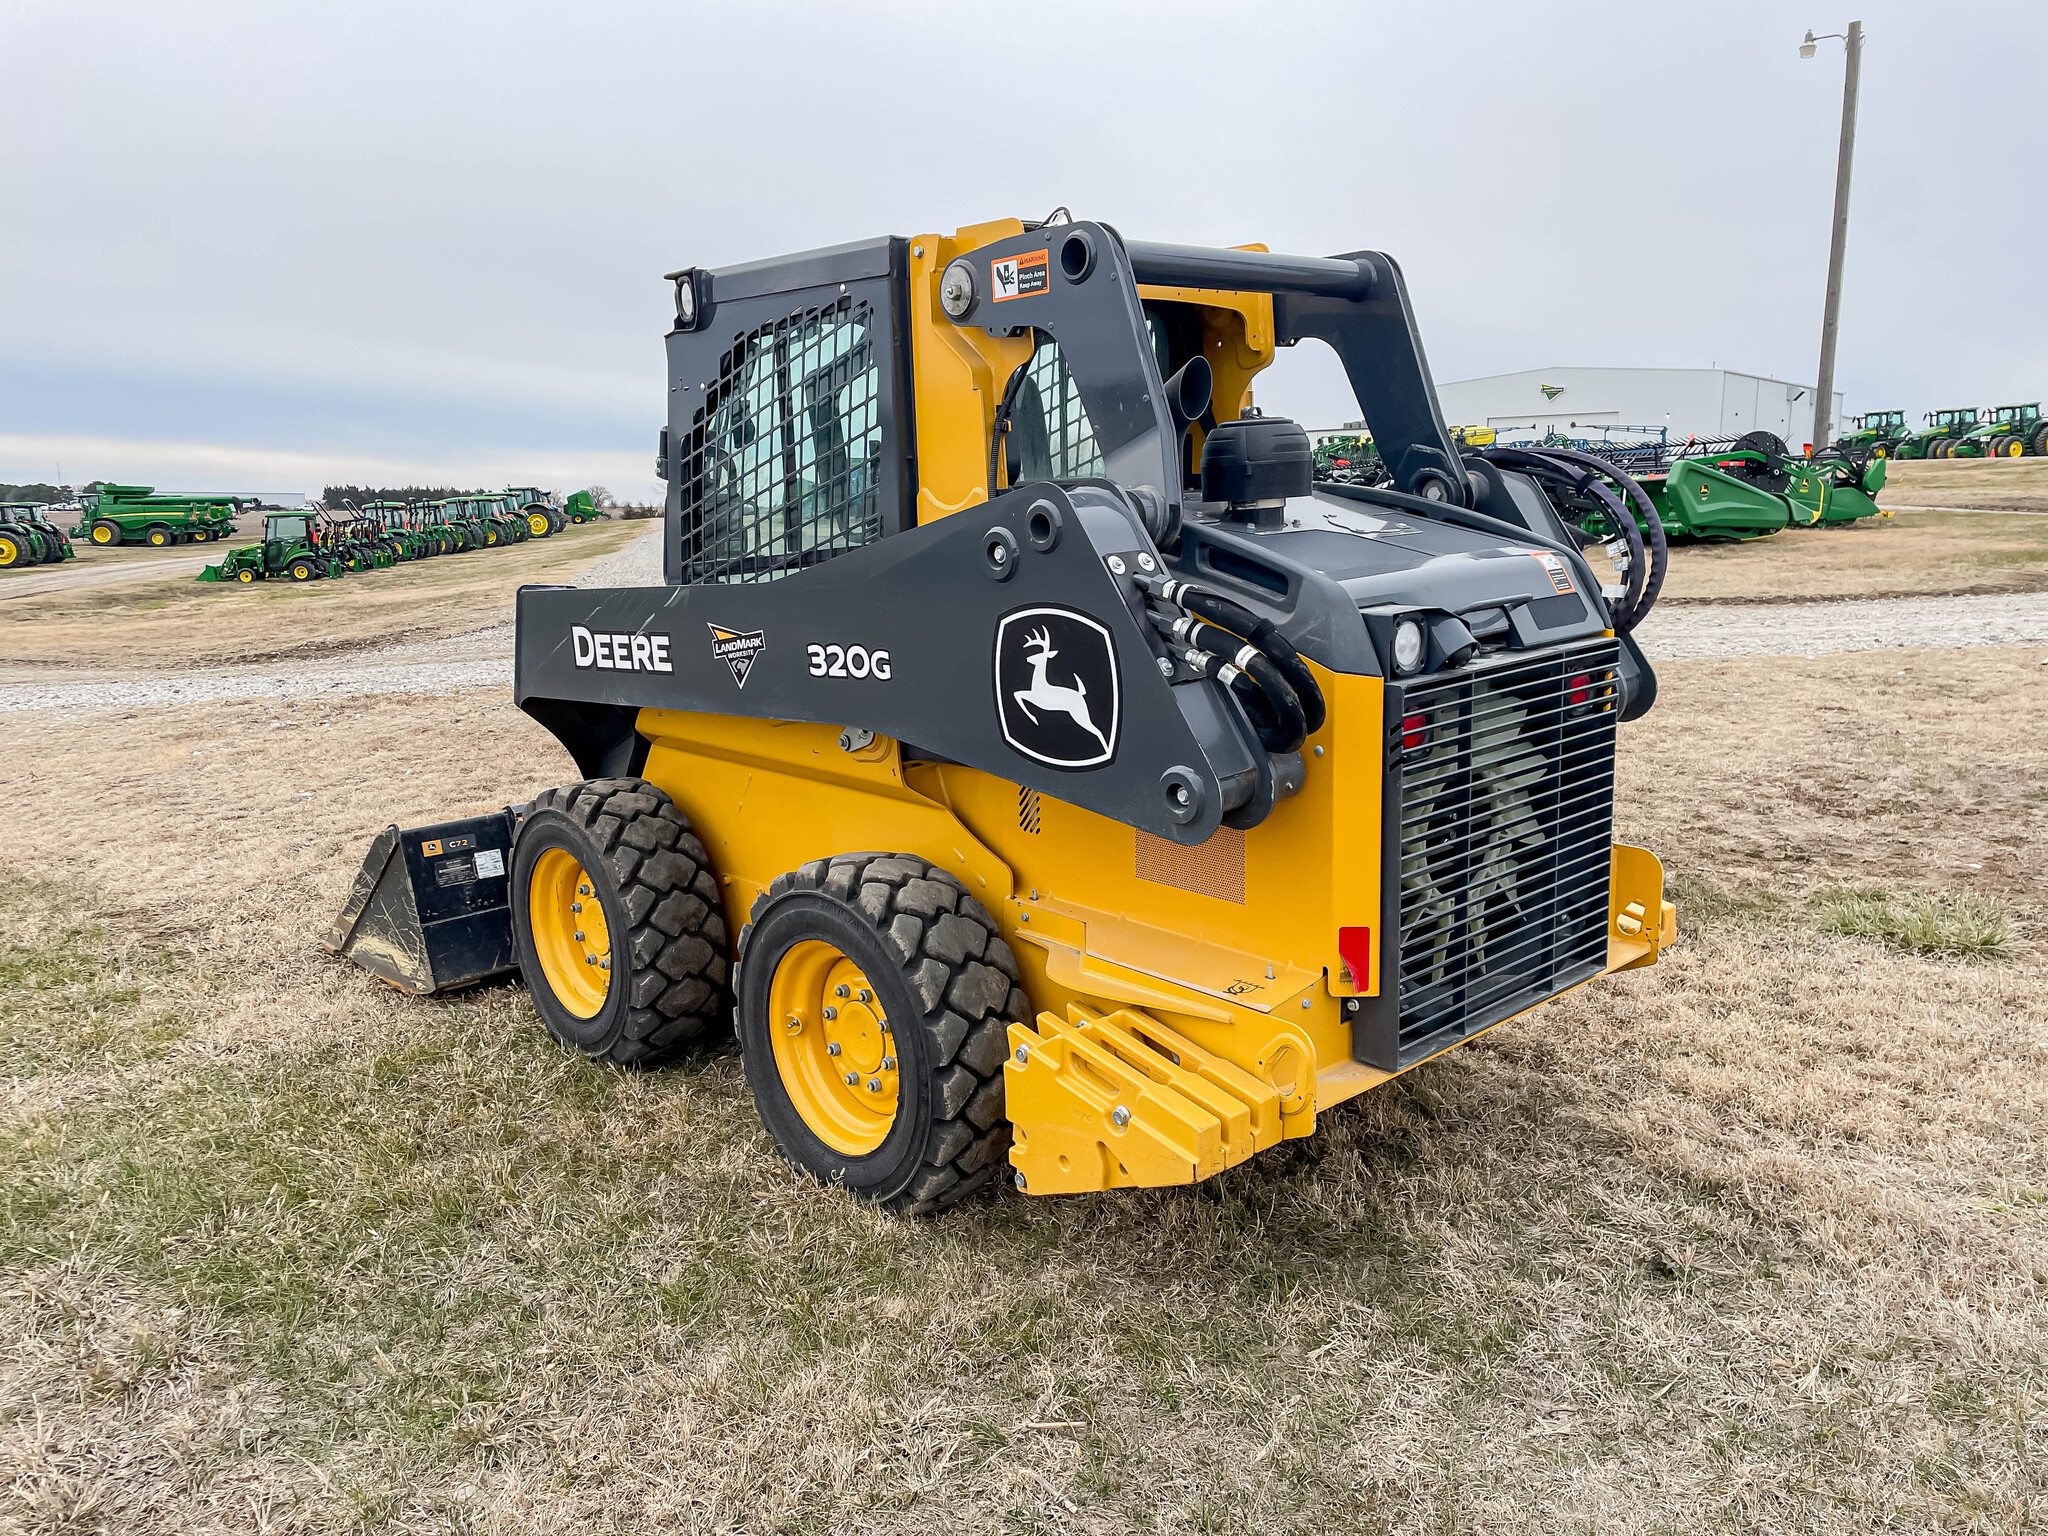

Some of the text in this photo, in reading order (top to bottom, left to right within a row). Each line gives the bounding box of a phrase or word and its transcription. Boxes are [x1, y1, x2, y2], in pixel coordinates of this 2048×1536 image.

[1019, 270, 1046, 281] Pinch Area
[571, 625, 673, 672] DEERE
[715, 636, 763, 654] LANDMARK
[727, 649, 755, 659] WORKSITE
[807, 644, 892, 680] 320G
[449, 839, 468, 848] C72
